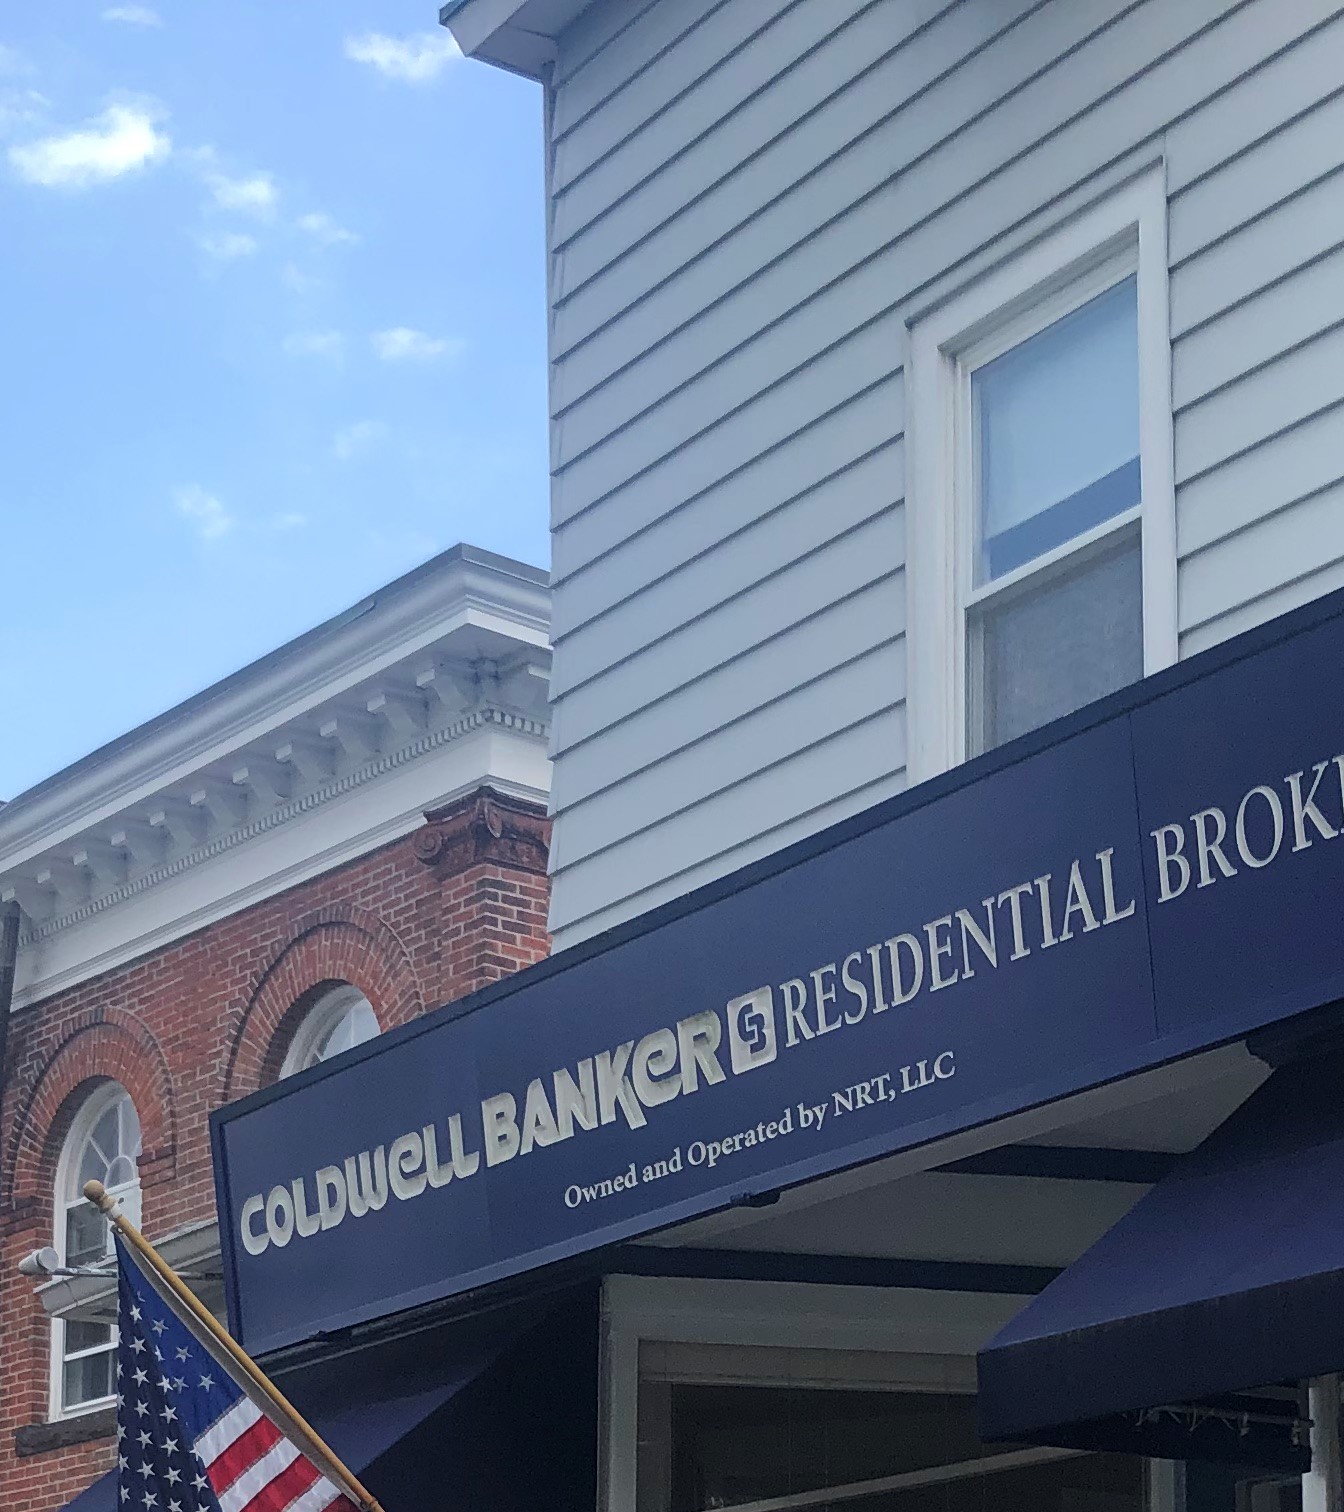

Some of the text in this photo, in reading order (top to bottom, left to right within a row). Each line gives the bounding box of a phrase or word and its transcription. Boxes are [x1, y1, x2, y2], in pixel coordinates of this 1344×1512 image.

[779, 847, 1135, 1047] RESIDENTIAL
[564, 1051, 956, 1209] Owned and Operated by NRT, LLC
